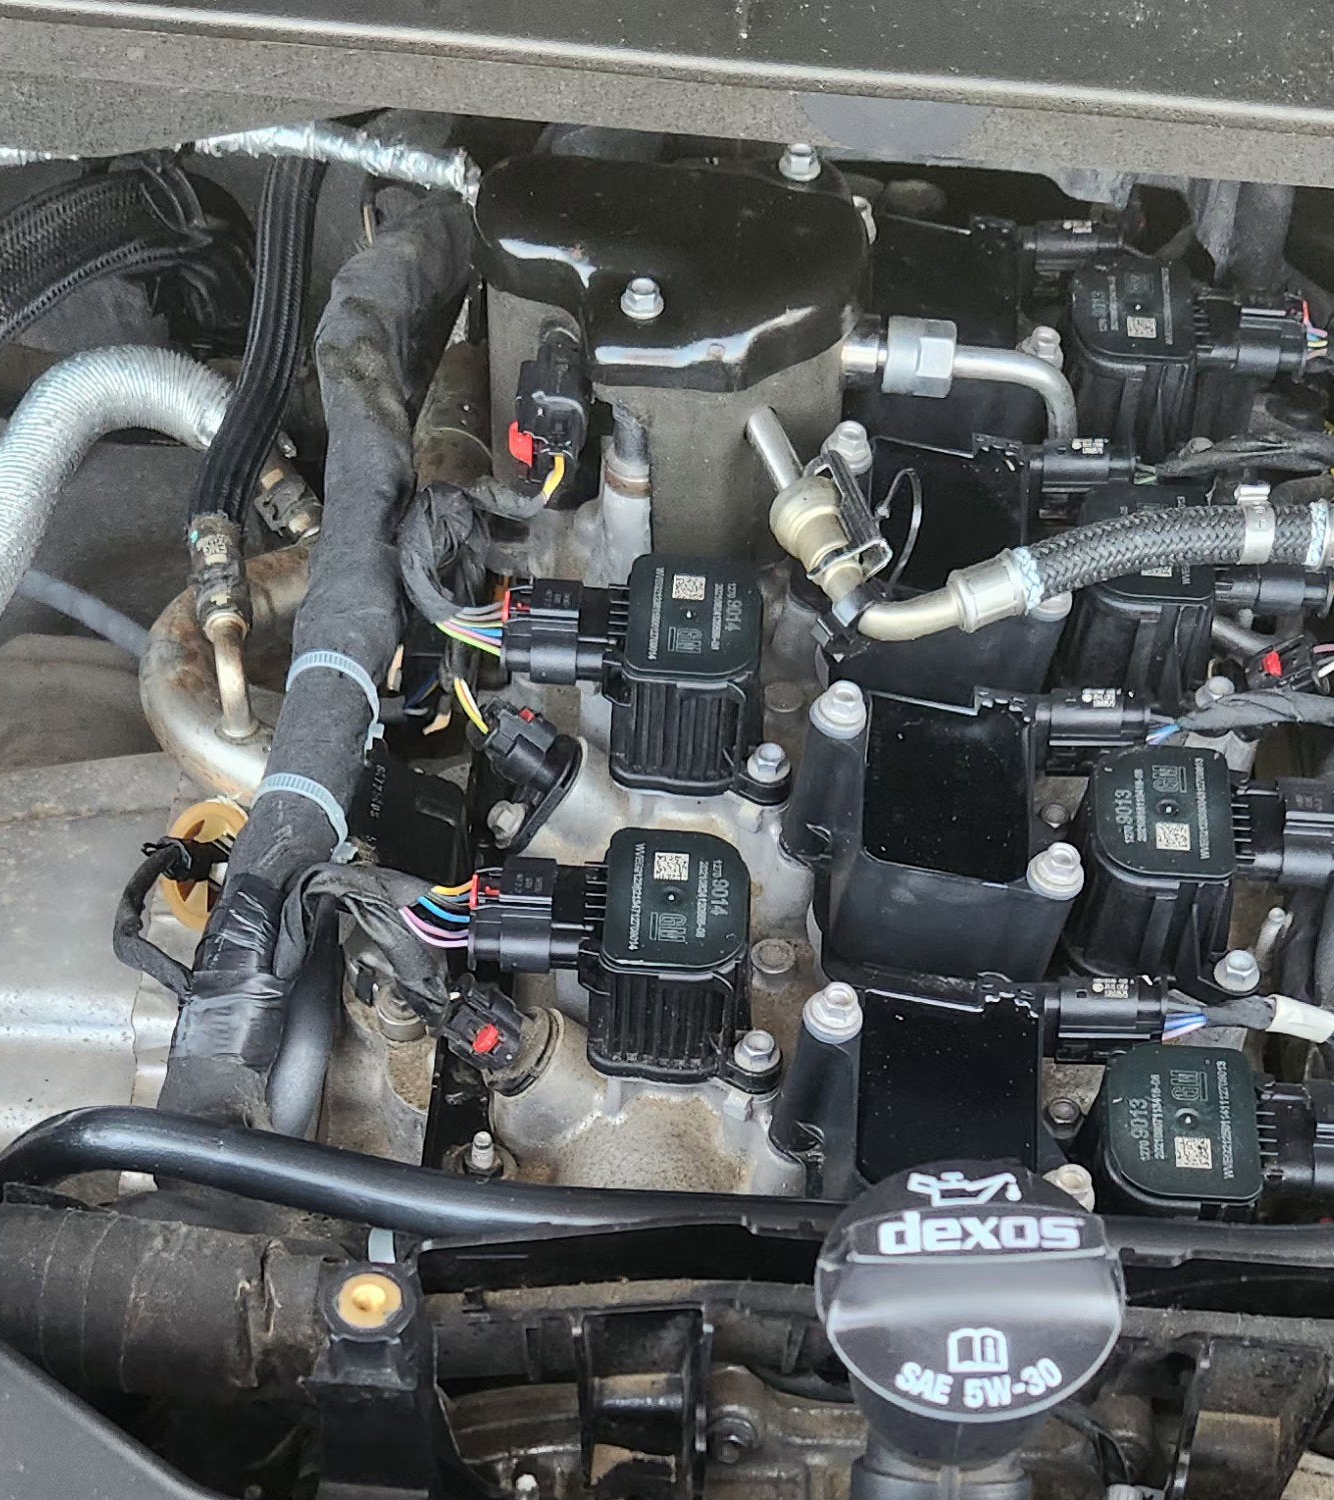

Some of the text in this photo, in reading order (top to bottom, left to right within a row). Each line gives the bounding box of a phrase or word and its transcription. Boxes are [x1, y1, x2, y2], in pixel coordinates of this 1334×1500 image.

[725, 599, 742, 632] 9014
[1114, 789, 1134, 825] 9013
[710, 878, 730, 917] 9014
[657, 912, 687, 943] GM
[1170, 1069, 1201, 1101] GM
[1129, 1098, 1149, 1139] 9013
[879, 1211, 1081, 1254] dexos
[895, 1357, 1063, 1409] SAE 5W-30
